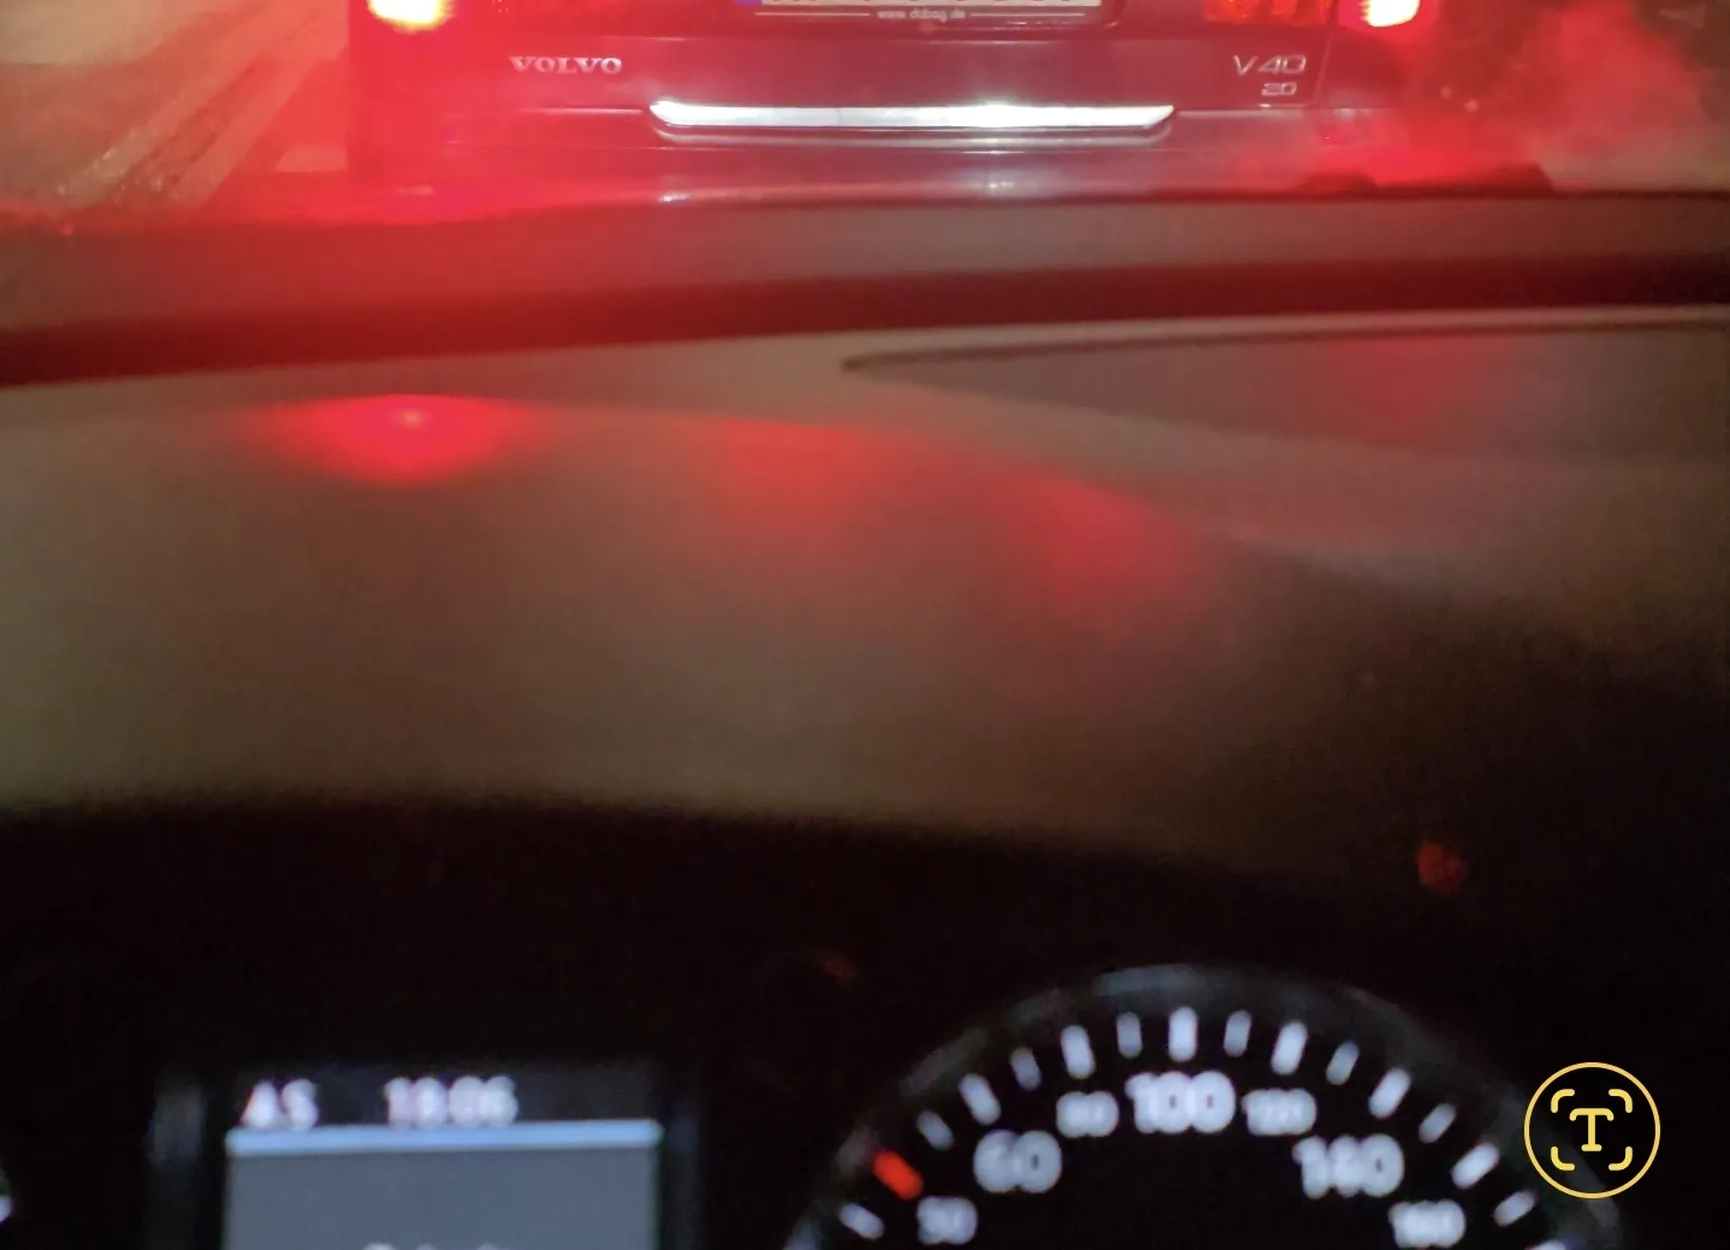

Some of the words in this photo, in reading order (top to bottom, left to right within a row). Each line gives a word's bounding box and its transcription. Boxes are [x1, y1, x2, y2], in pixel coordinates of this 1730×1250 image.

[508, 56, 622, 74] VOLVO
[1232, 54, 1307, 75] V40
[1125, 1071, 1236, 1134] 100
